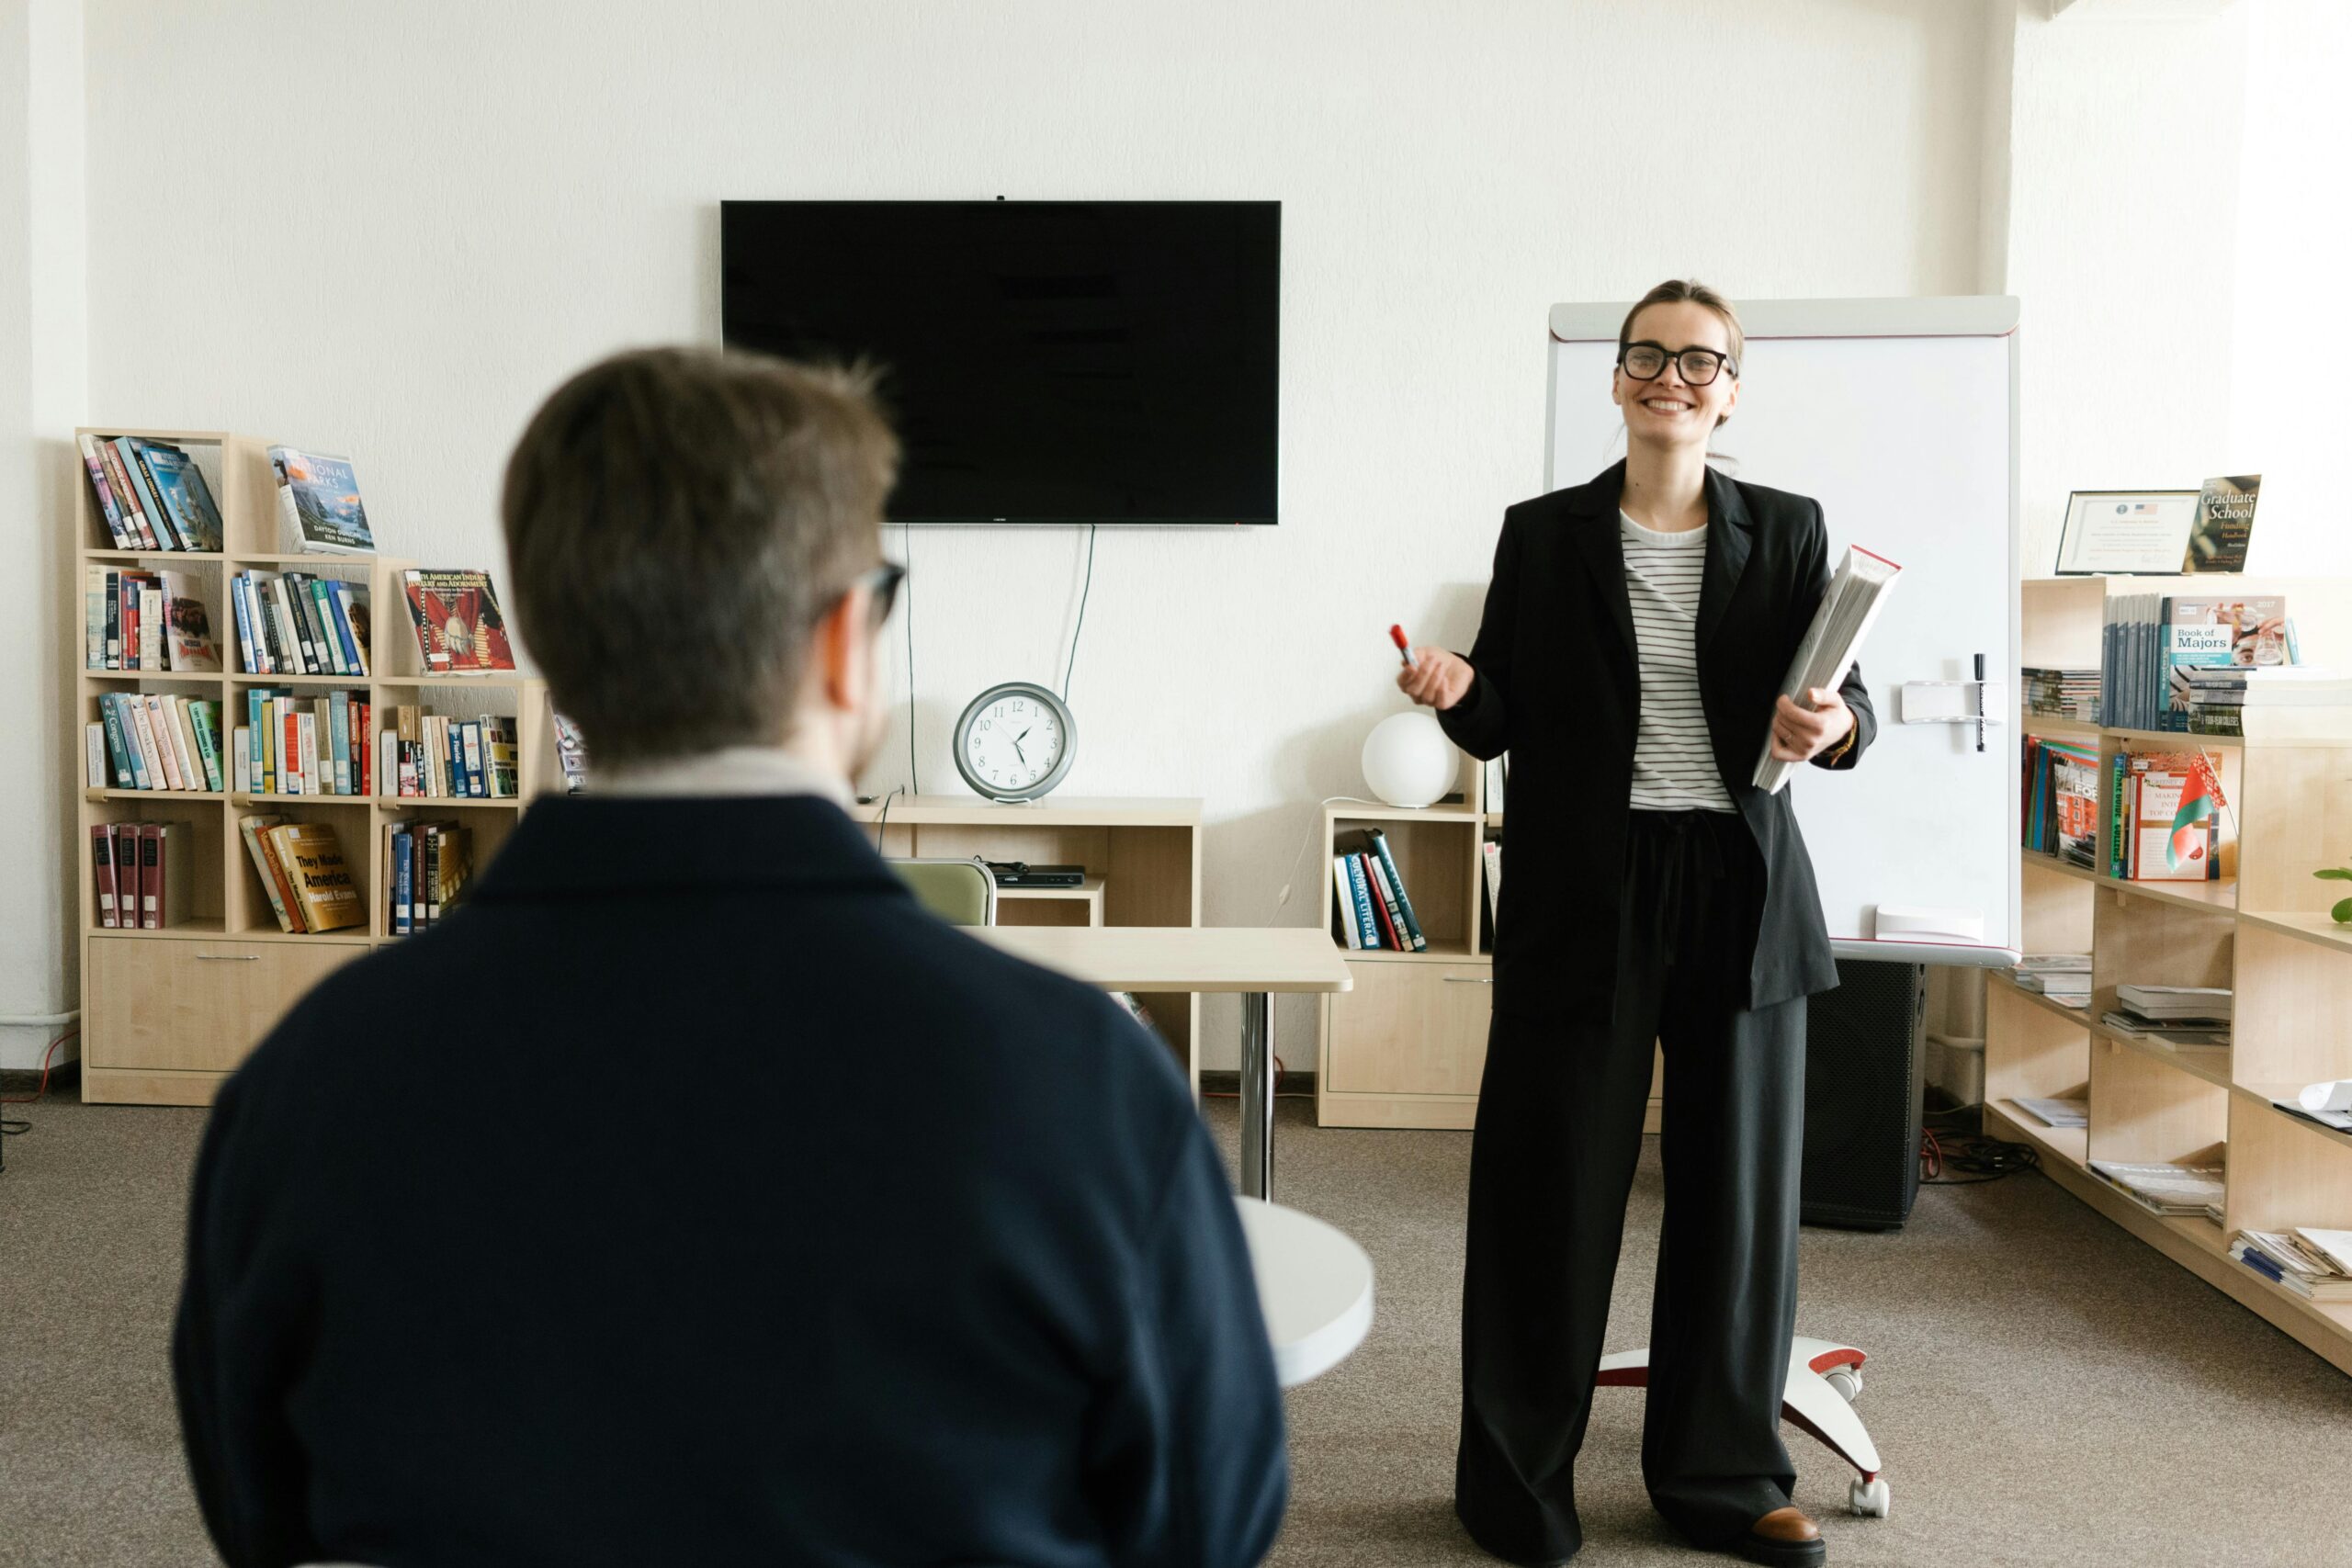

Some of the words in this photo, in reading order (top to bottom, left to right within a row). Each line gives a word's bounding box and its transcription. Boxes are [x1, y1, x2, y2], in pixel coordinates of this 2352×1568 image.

[308, 476, 339, 488] PARKS
[2201, 489, 2256, 505] Graduate
[2210, 503, 2253, 519] School
[314, 525, 336, 534] DAYTON
[2221, 522, 2249, 530] Funding
[338, 536, 355, 544] BURNS
[2178, 638, 2226, 650] Majors
[1012, 701, 1024, 712] 12
[1034, 706, 1038, 717] 1
[994, 707, 1004, 718] 11
[980, 720, 991, 731] 10
[1046, 720, 1053, 730] 2
[109, 717, 121, 753] Congress
[975, 738, 981, 749] 9
[1051, 739, 1057, 749] 3
[453, 741, 461, 763] Florida
[978, 756, 985, 767] 8
[1044, 758, 1050, 768] 4
[993, 770, 999, 780] 7
[1011, 775, 1017, 785] 6
[1030, 770, 1036, 781] 5
[296, 855, 318, 869] They
[320, 854, 344, 866] Made
[304, 872, 351, 888] America
[1351, 854, 1365, 900] CULTURAL
[309, 892, 334, 903] Harold
[335, 890, 357, 899] Evans
